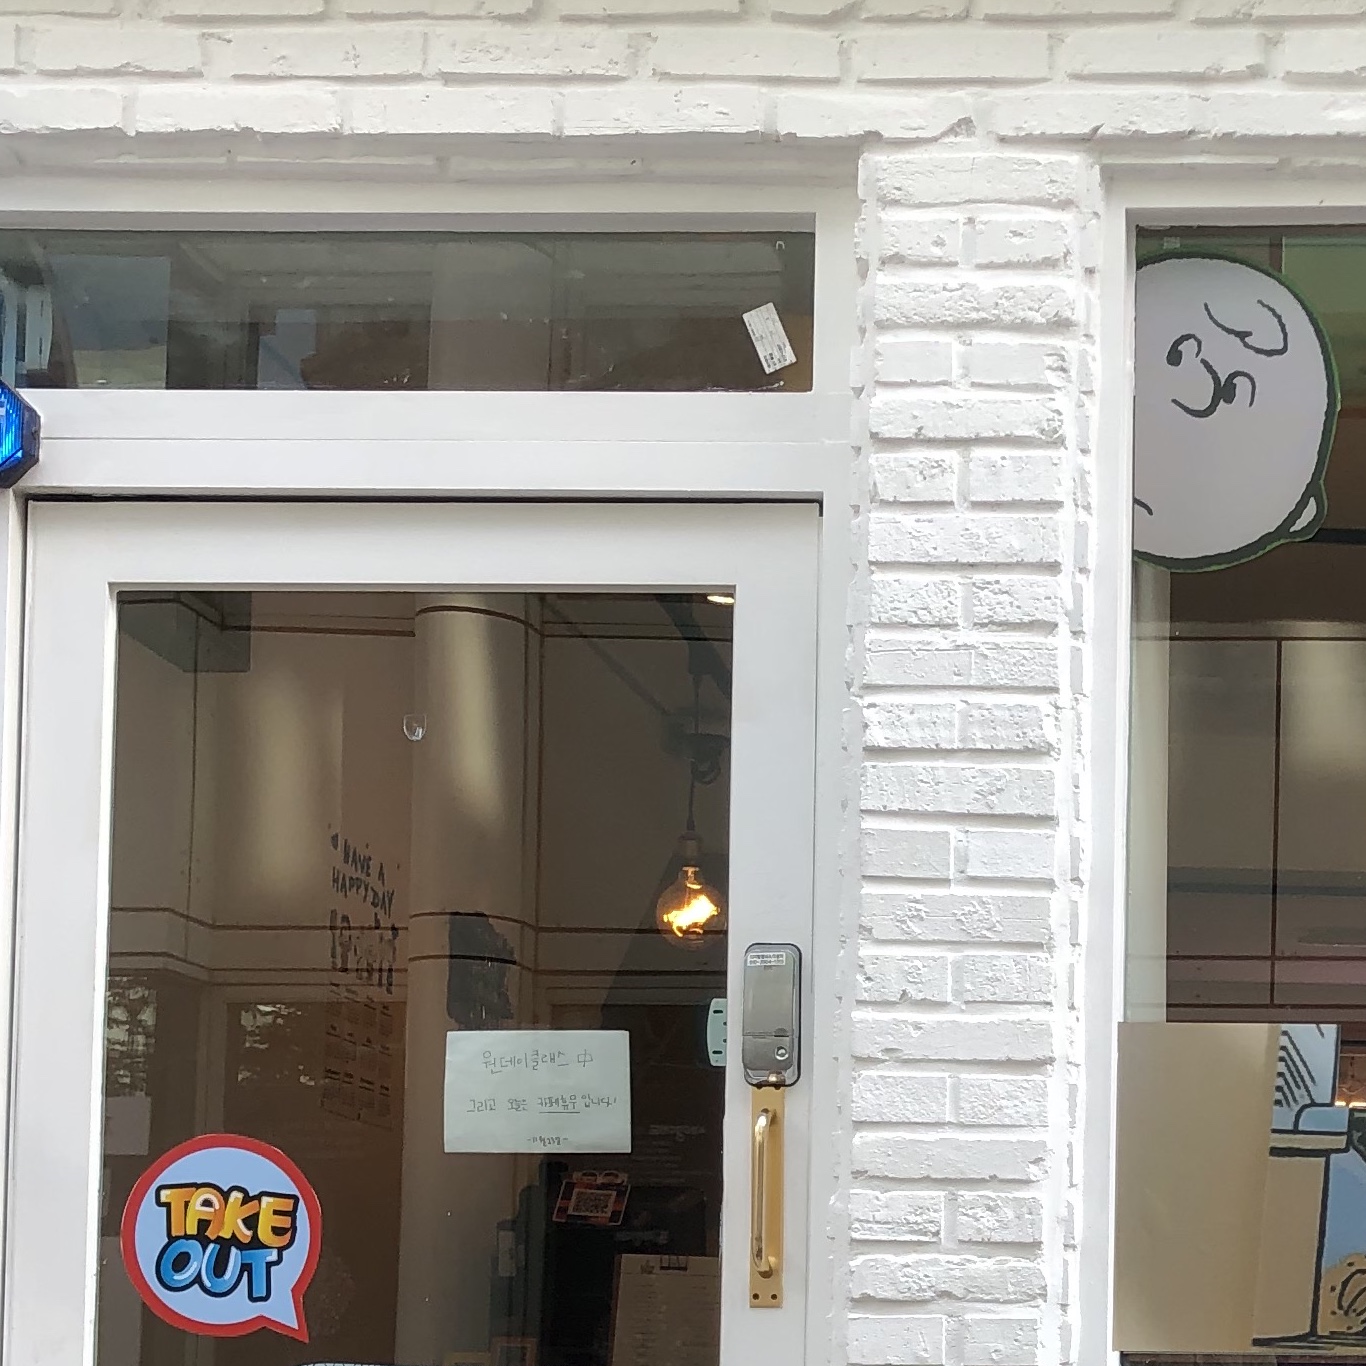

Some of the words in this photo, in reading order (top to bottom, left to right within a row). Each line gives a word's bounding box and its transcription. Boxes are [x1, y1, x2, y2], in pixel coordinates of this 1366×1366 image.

[466, 1098, 497, 1112] 그리고
[156, 1183, 299, 1248] TAKE
[156, 1240, 282, 1302] OUT
